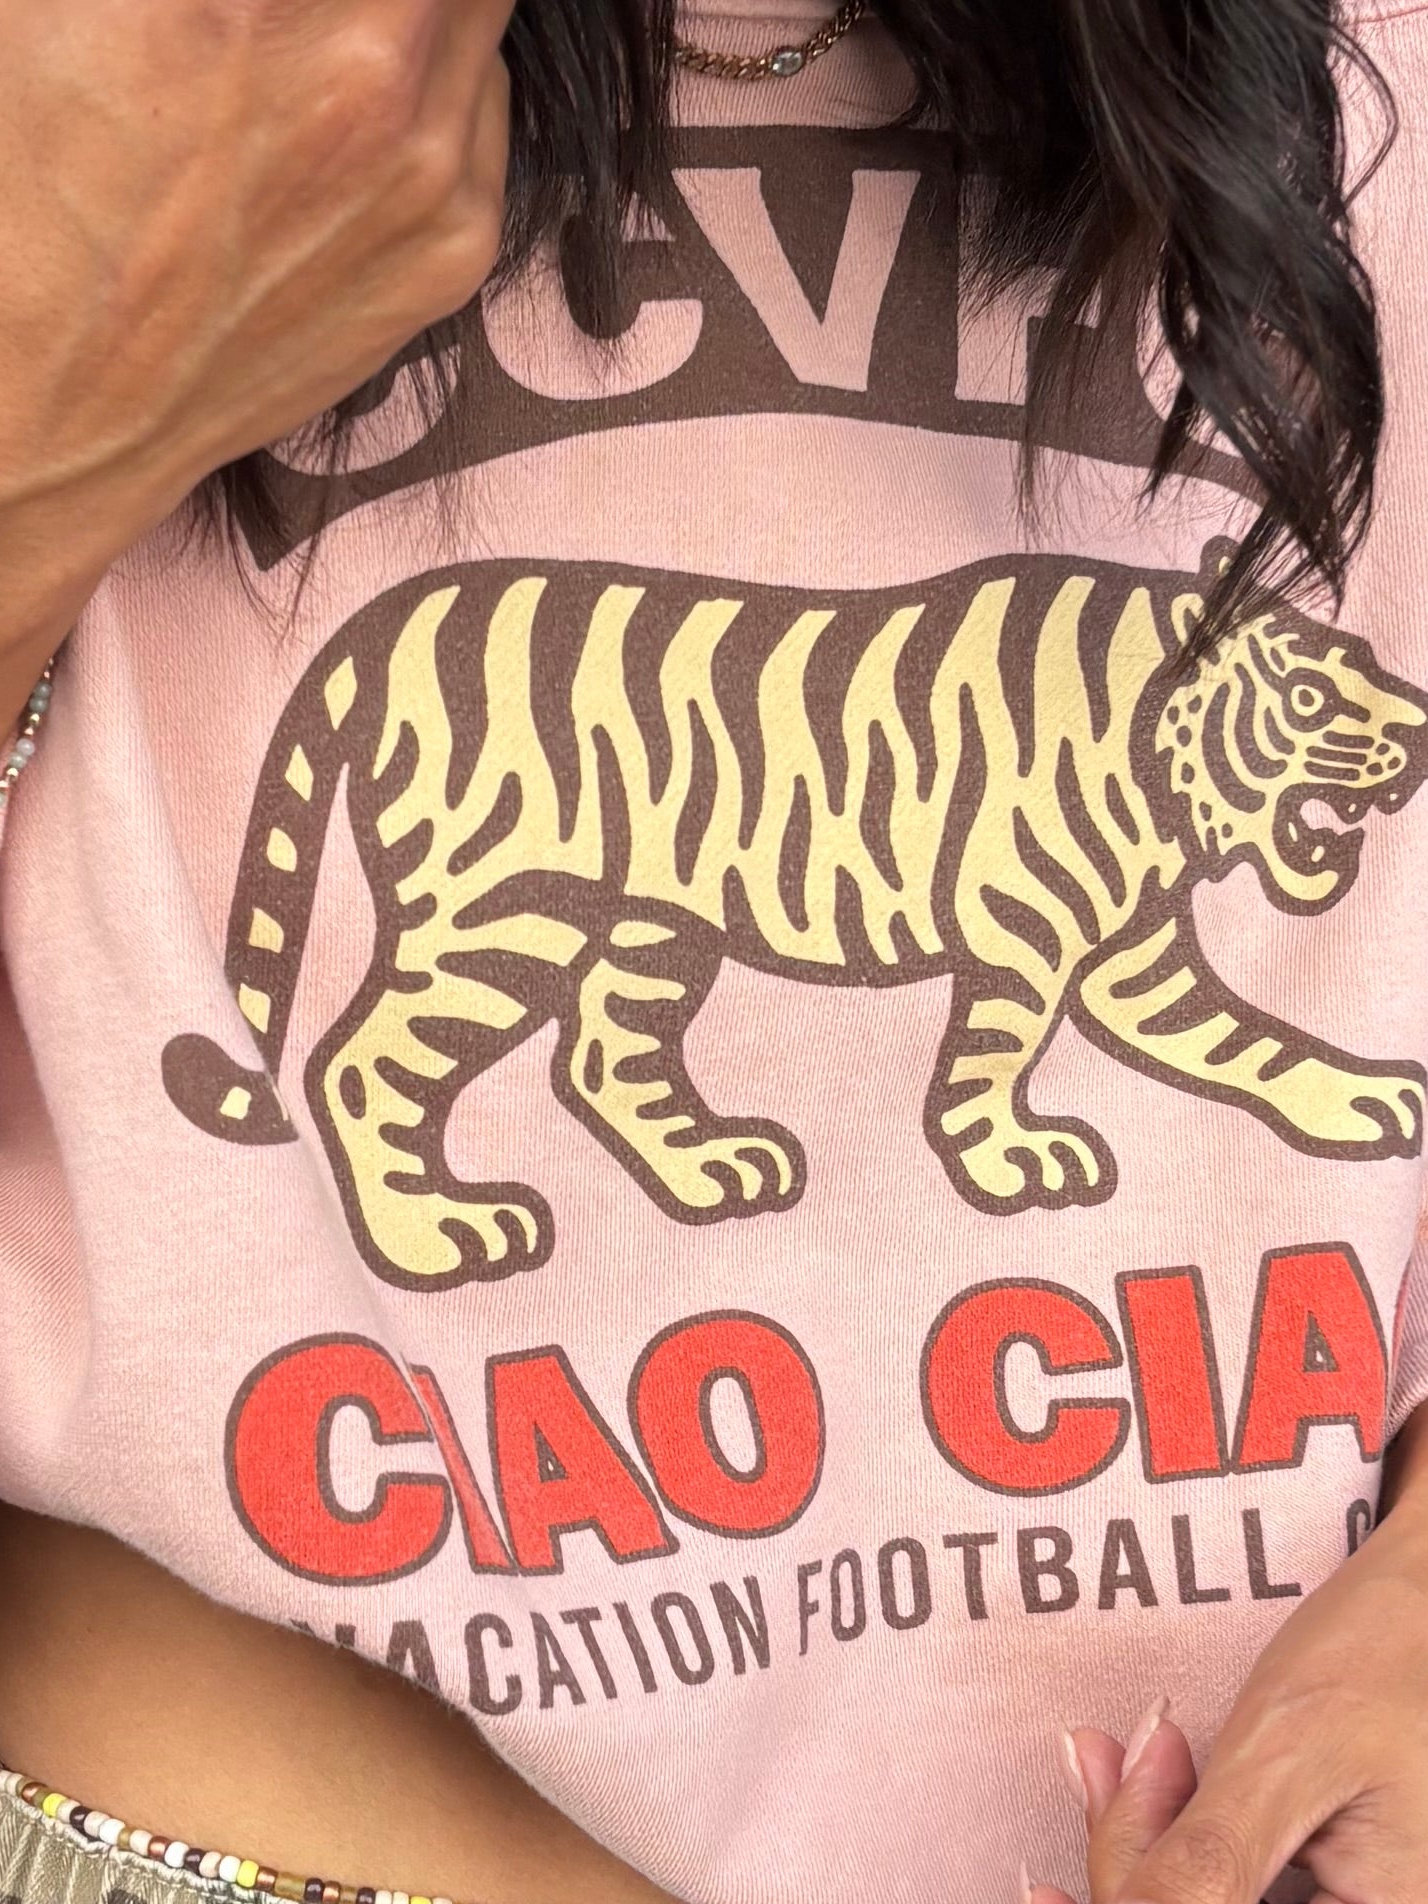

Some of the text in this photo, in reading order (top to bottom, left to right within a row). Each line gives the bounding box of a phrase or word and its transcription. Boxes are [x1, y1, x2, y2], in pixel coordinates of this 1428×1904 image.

[224, 1241, 1410, 1587] CIAO CIA
[290, 1575, 771, 1716] ACATION
[797, 1507, 1303, 1656] FOOTBALL
